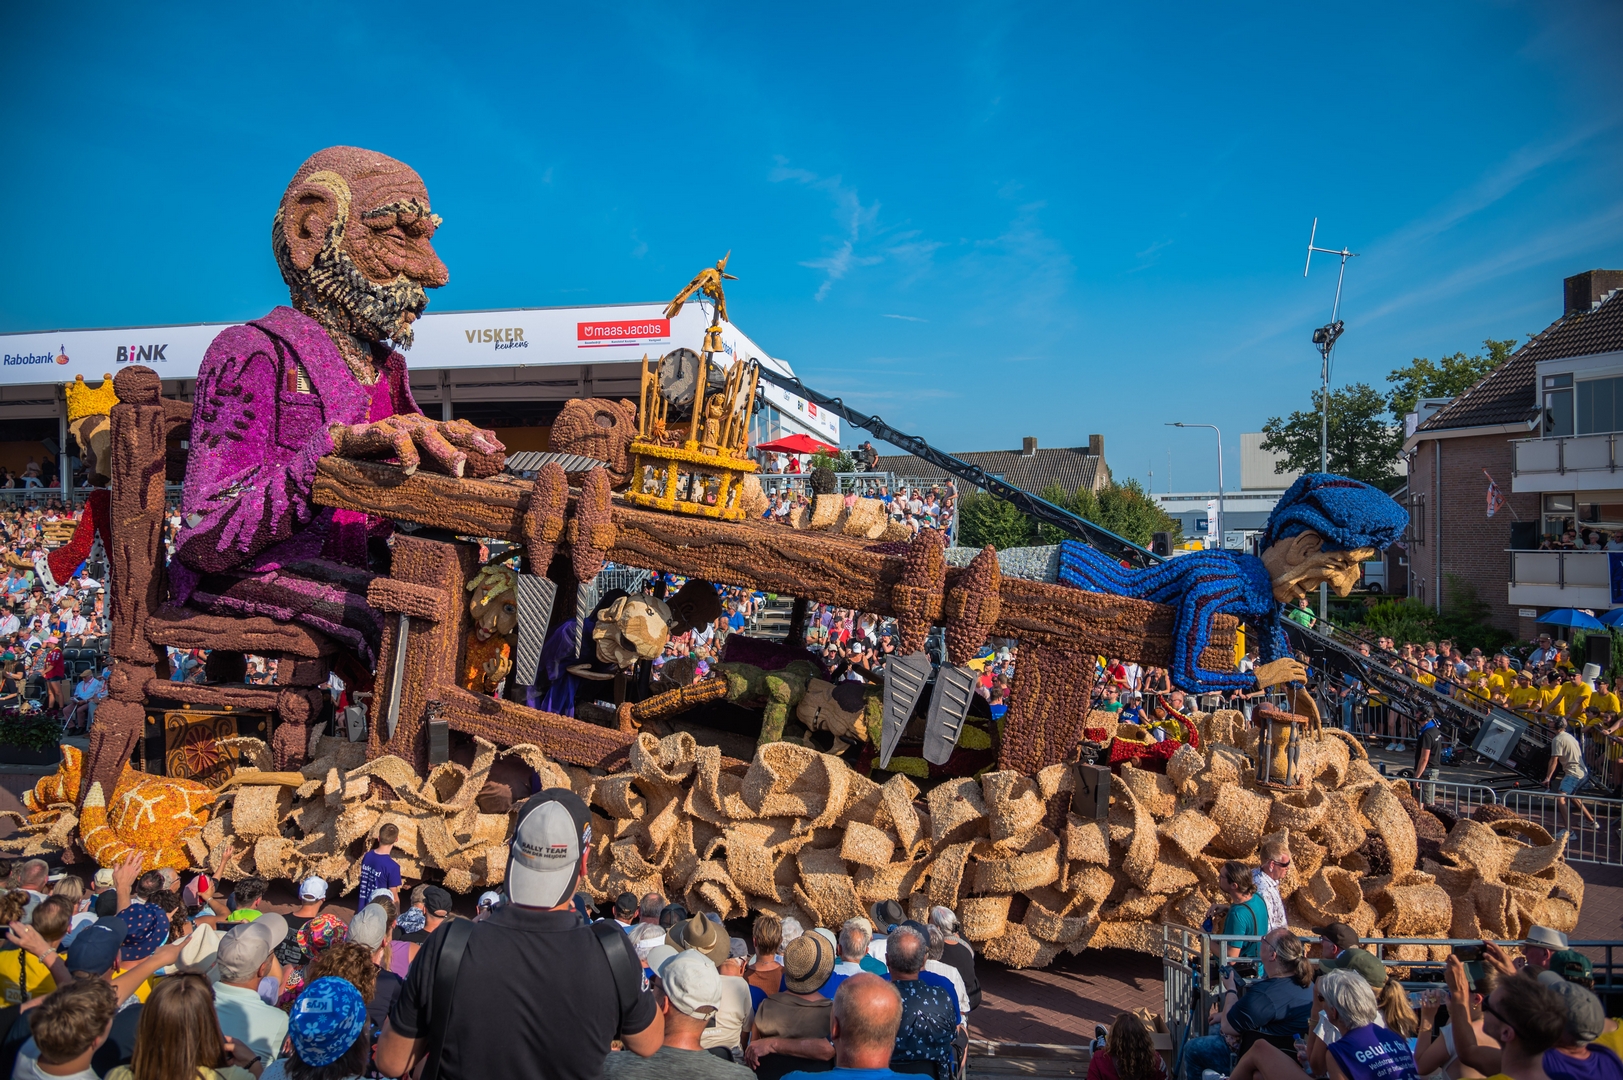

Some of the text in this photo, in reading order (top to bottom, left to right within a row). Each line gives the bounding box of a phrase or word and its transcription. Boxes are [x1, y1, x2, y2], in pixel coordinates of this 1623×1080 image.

[465, 327, 524, 343] VISKER
[495, 337, 530, 350] keukens
[3, 352, 53, 365] Rabobank
[116, 344, 168, 363] BiNK
[522, 842, 543, 852] RALLY
[307, 1000, 328, 1011] Krys
[1355, 1041, 1397, 1063] Gelukt,
